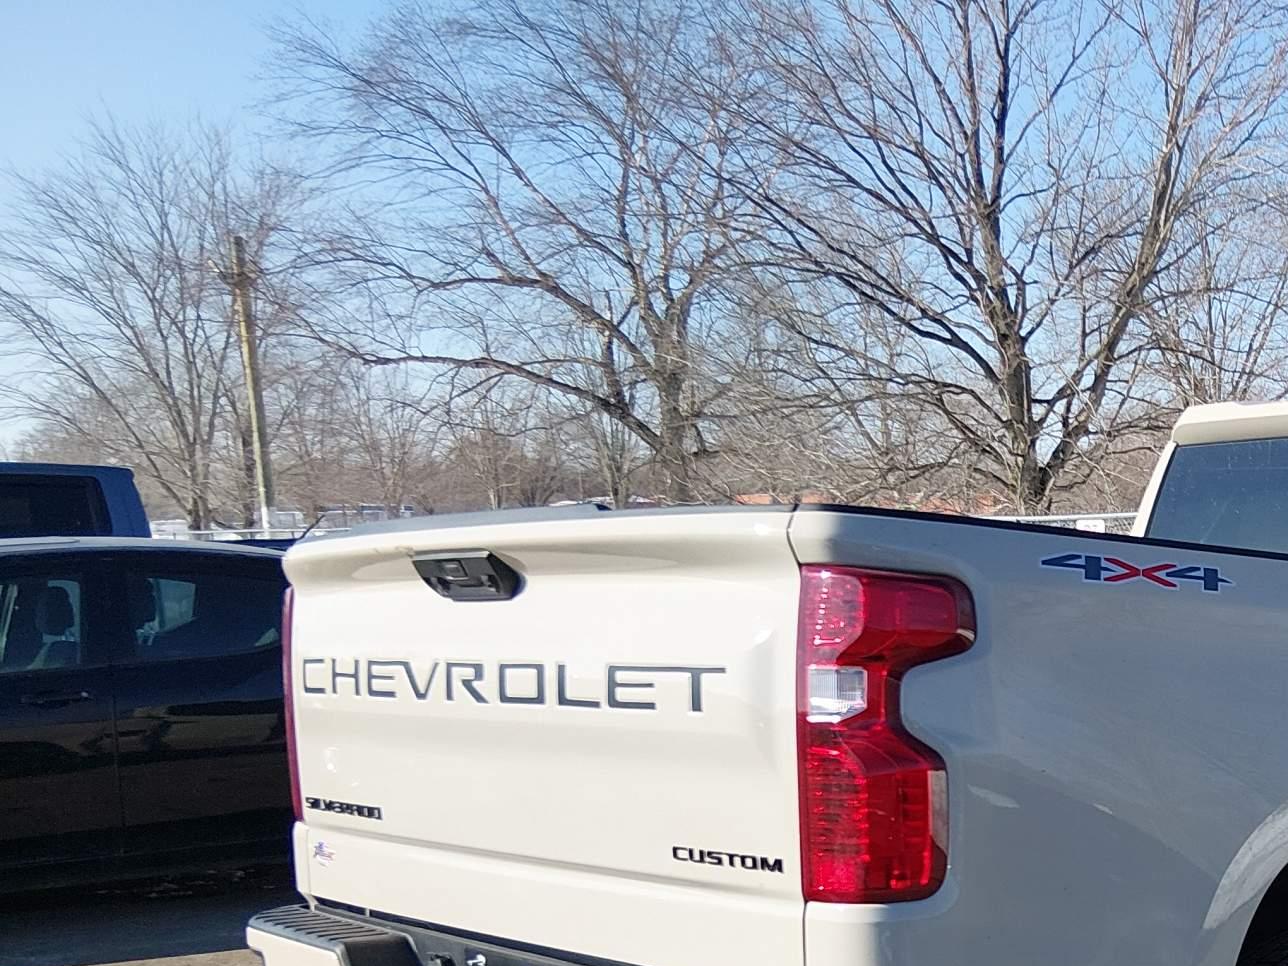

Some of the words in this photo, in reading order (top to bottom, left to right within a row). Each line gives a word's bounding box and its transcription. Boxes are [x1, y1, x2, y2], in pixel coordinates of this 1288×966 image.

[302, 657, 727, 713] CHEVROLET
[304, 796, 384, 821] SILVERADO
[672, 846, 785, 874] CUSTOM
